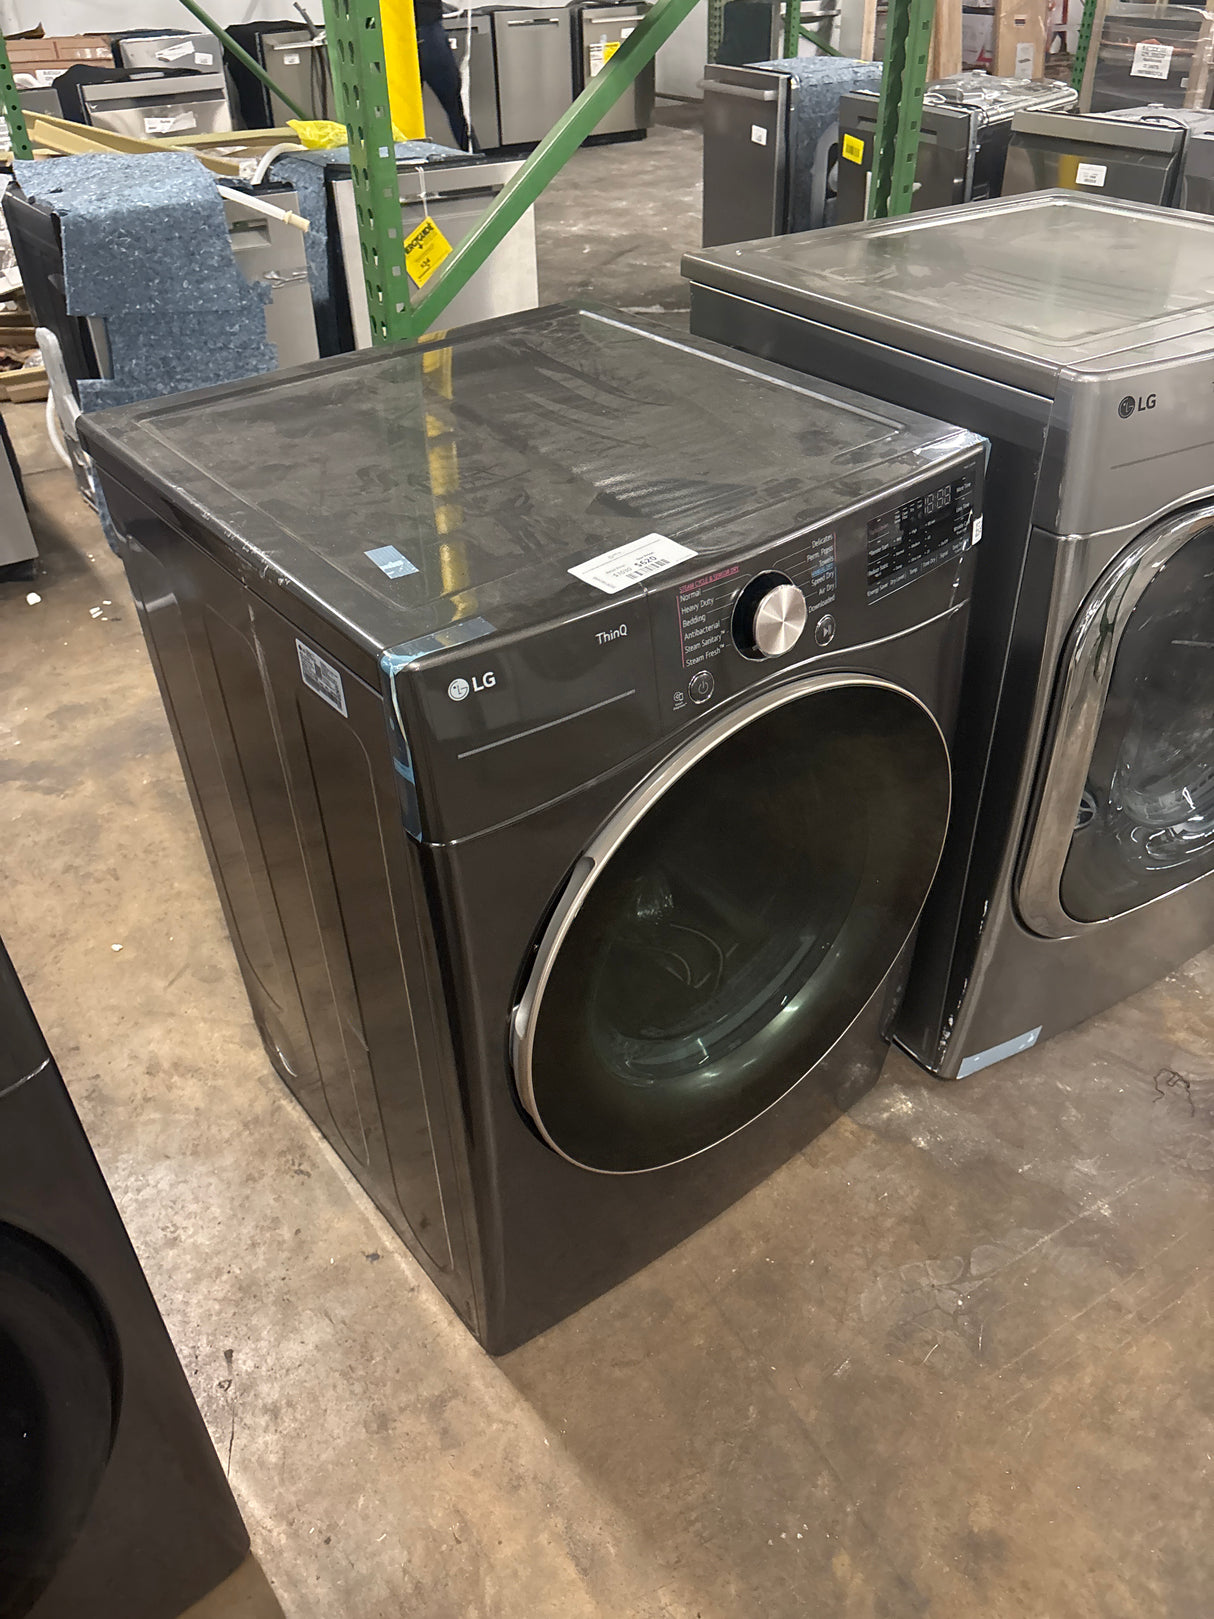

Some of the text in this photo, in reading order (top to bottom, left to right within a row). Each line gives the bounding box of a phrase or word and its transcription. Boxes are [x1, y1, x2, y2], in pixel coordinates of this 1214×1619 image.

[1138, 394, 1156, 412] LG
[812, 534, 833, 548] Delicates
[812, 571, 834, 586] Speed Dry
[680, 588, 702, 602] Normal
[826, 583, 834, 592] Dry
[681, 598, 714, 615] Heavy Duty
[808, 594, 835, 614] Downloaded
[682, 614, 706, 628] Bedding
[595, 623, 628, 646] ThinQ
[684, 621, 720, 641] Antibacterial
[684, 642, 700, 654] Steam
[686, 655, 704, 668] Steam
[472, 671, 497, 693] LG
